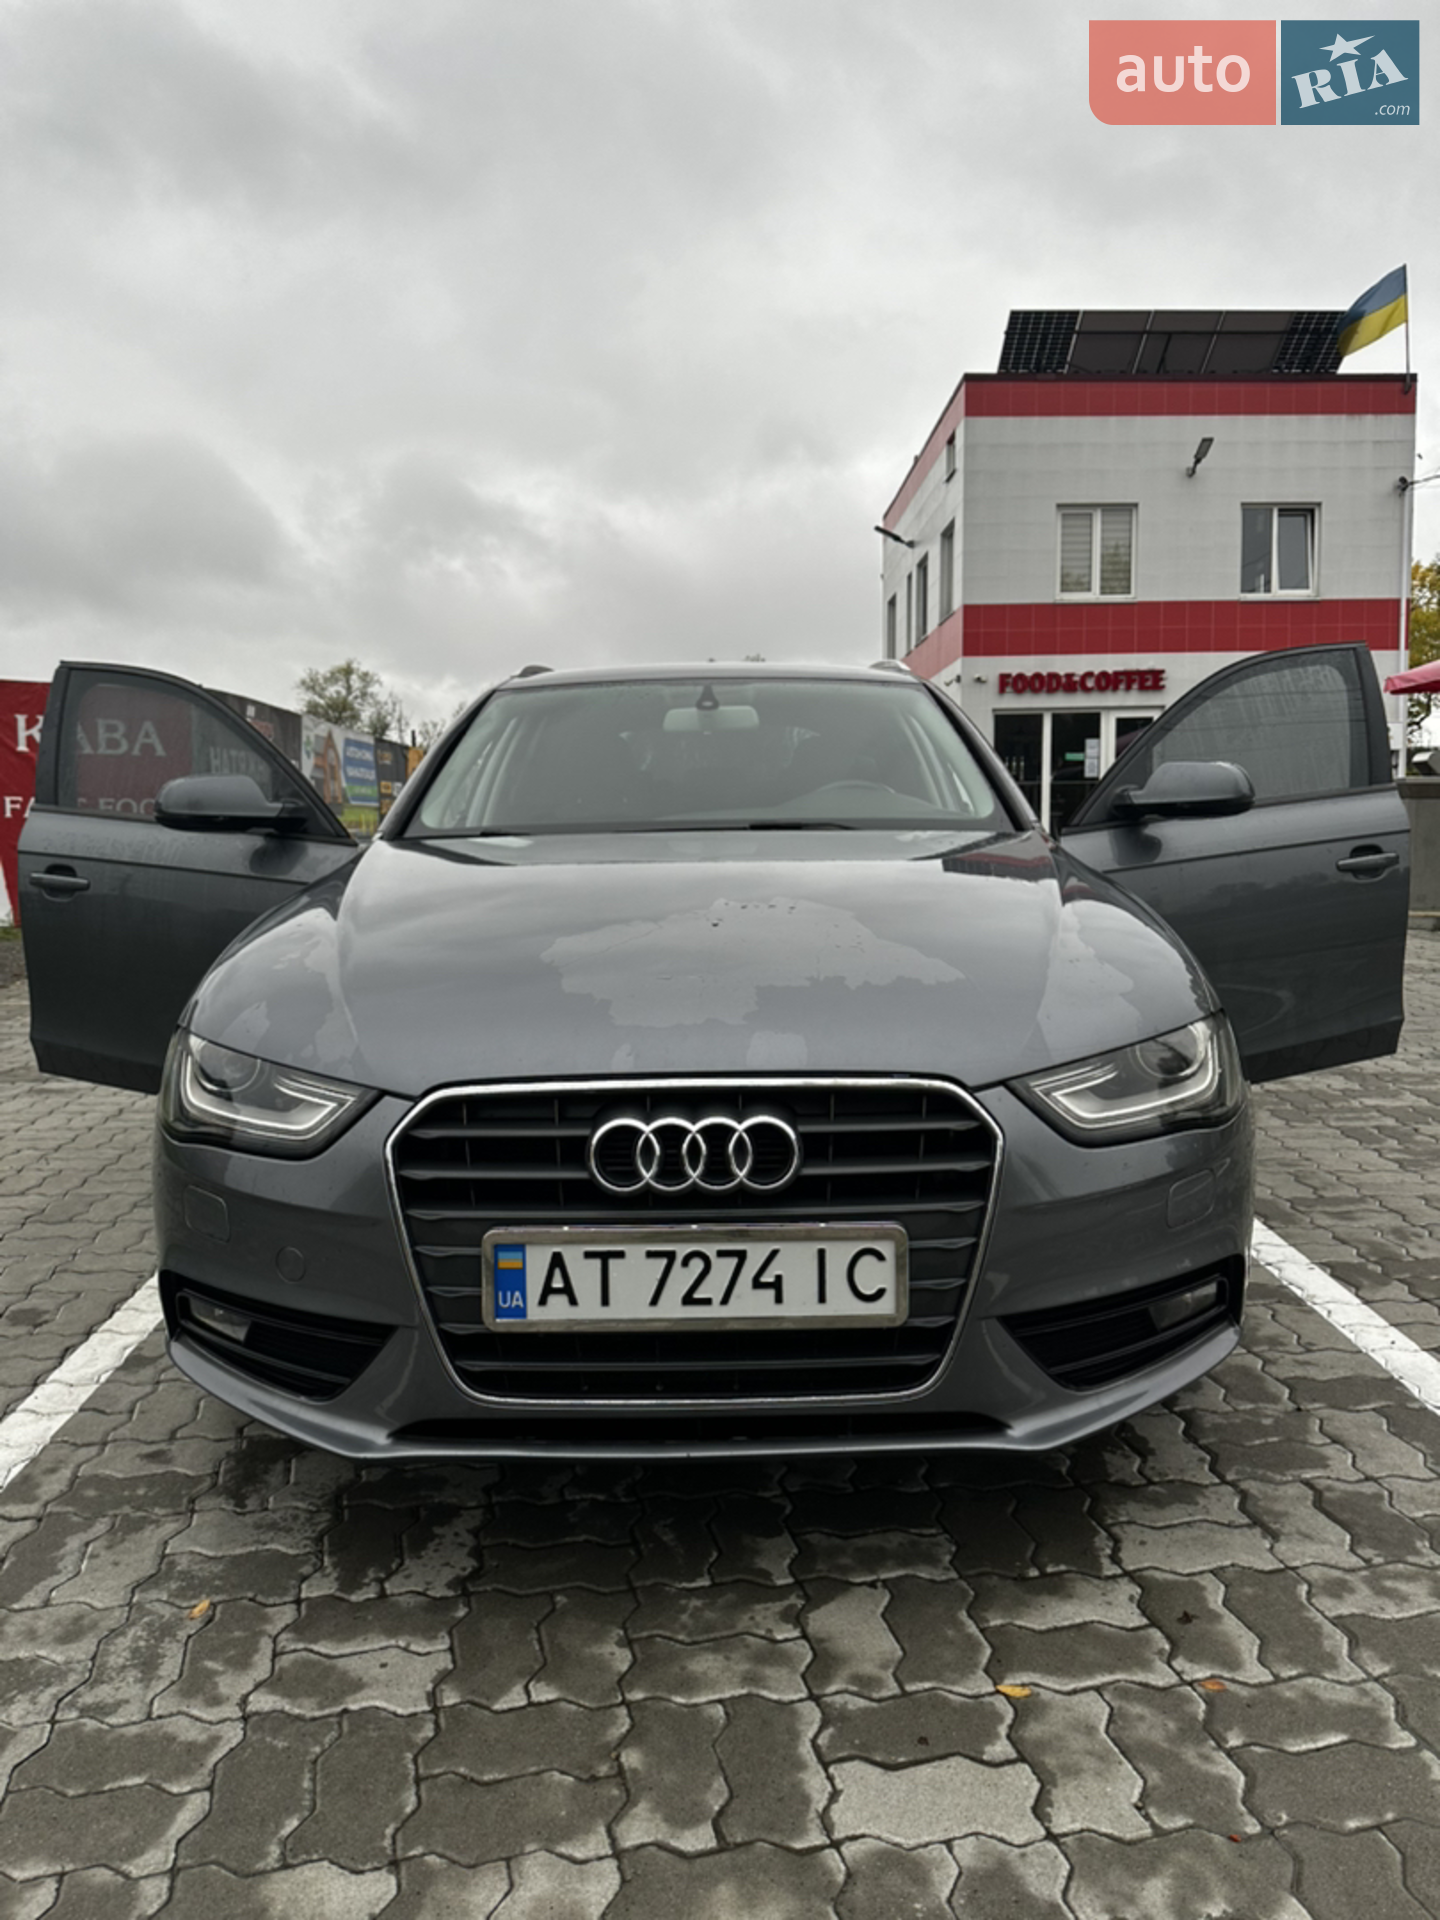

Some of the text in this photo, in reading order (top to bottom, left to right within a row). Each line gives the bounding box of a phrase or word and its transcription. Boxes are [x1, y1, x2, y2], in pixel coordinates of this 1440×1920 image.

[999, 669, 1166, 694] FOOD&COFFEE
[537, 1247, 887, 1307] AT 7274 IC
[498, 1291, 524, 1308] UA
